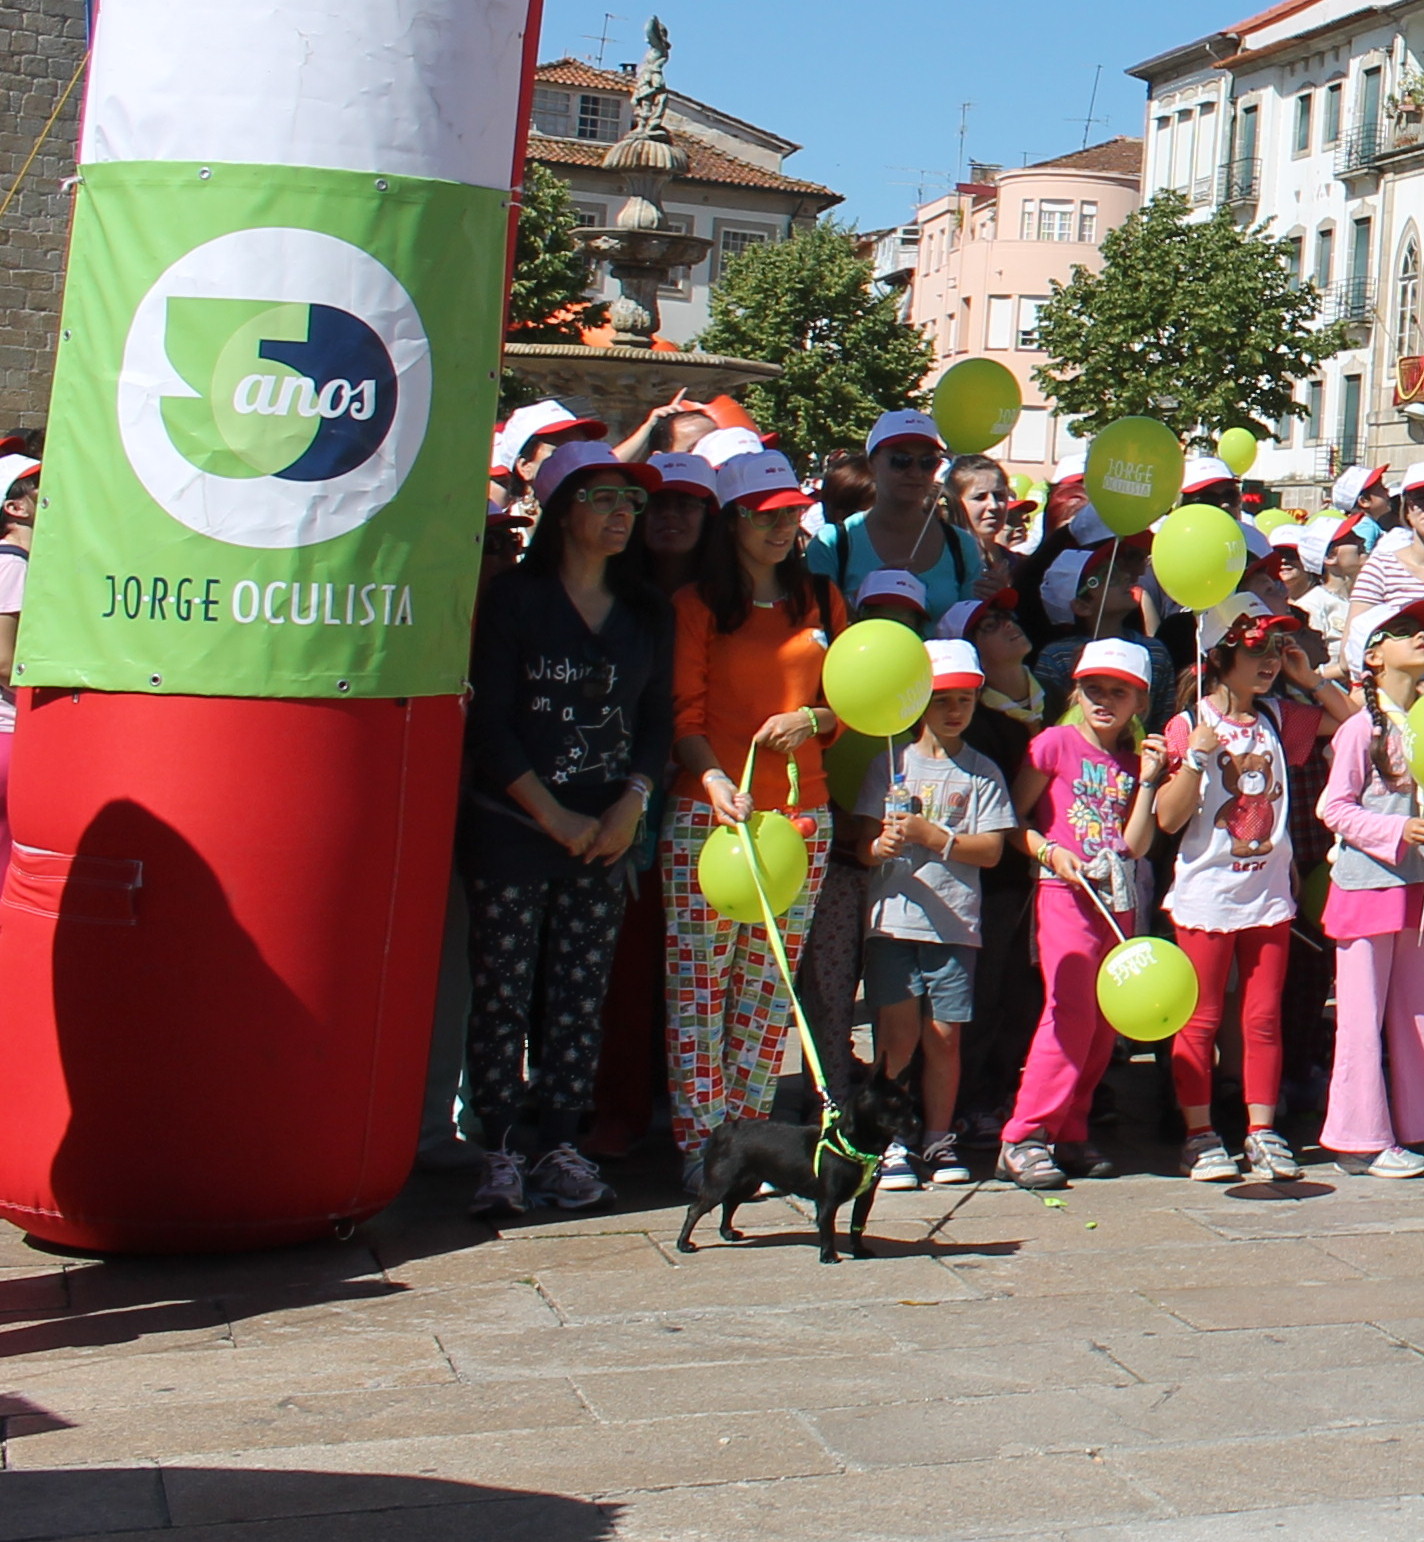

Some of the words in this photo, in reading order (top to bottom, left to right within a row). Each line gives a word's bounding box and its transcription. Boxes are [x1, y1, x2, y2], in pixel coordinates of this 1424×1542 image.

[233, 373, 377, 421] anos
[1108, 458, 1153, 483] JORGE
[102, 575, 221, 622] JORGE
[232, 579, 413, 626] OCULISTA
[531, 695, 551, 712] on
[562, 706, 575, 721] a
[1232, 861, 1267, 873] Bear
